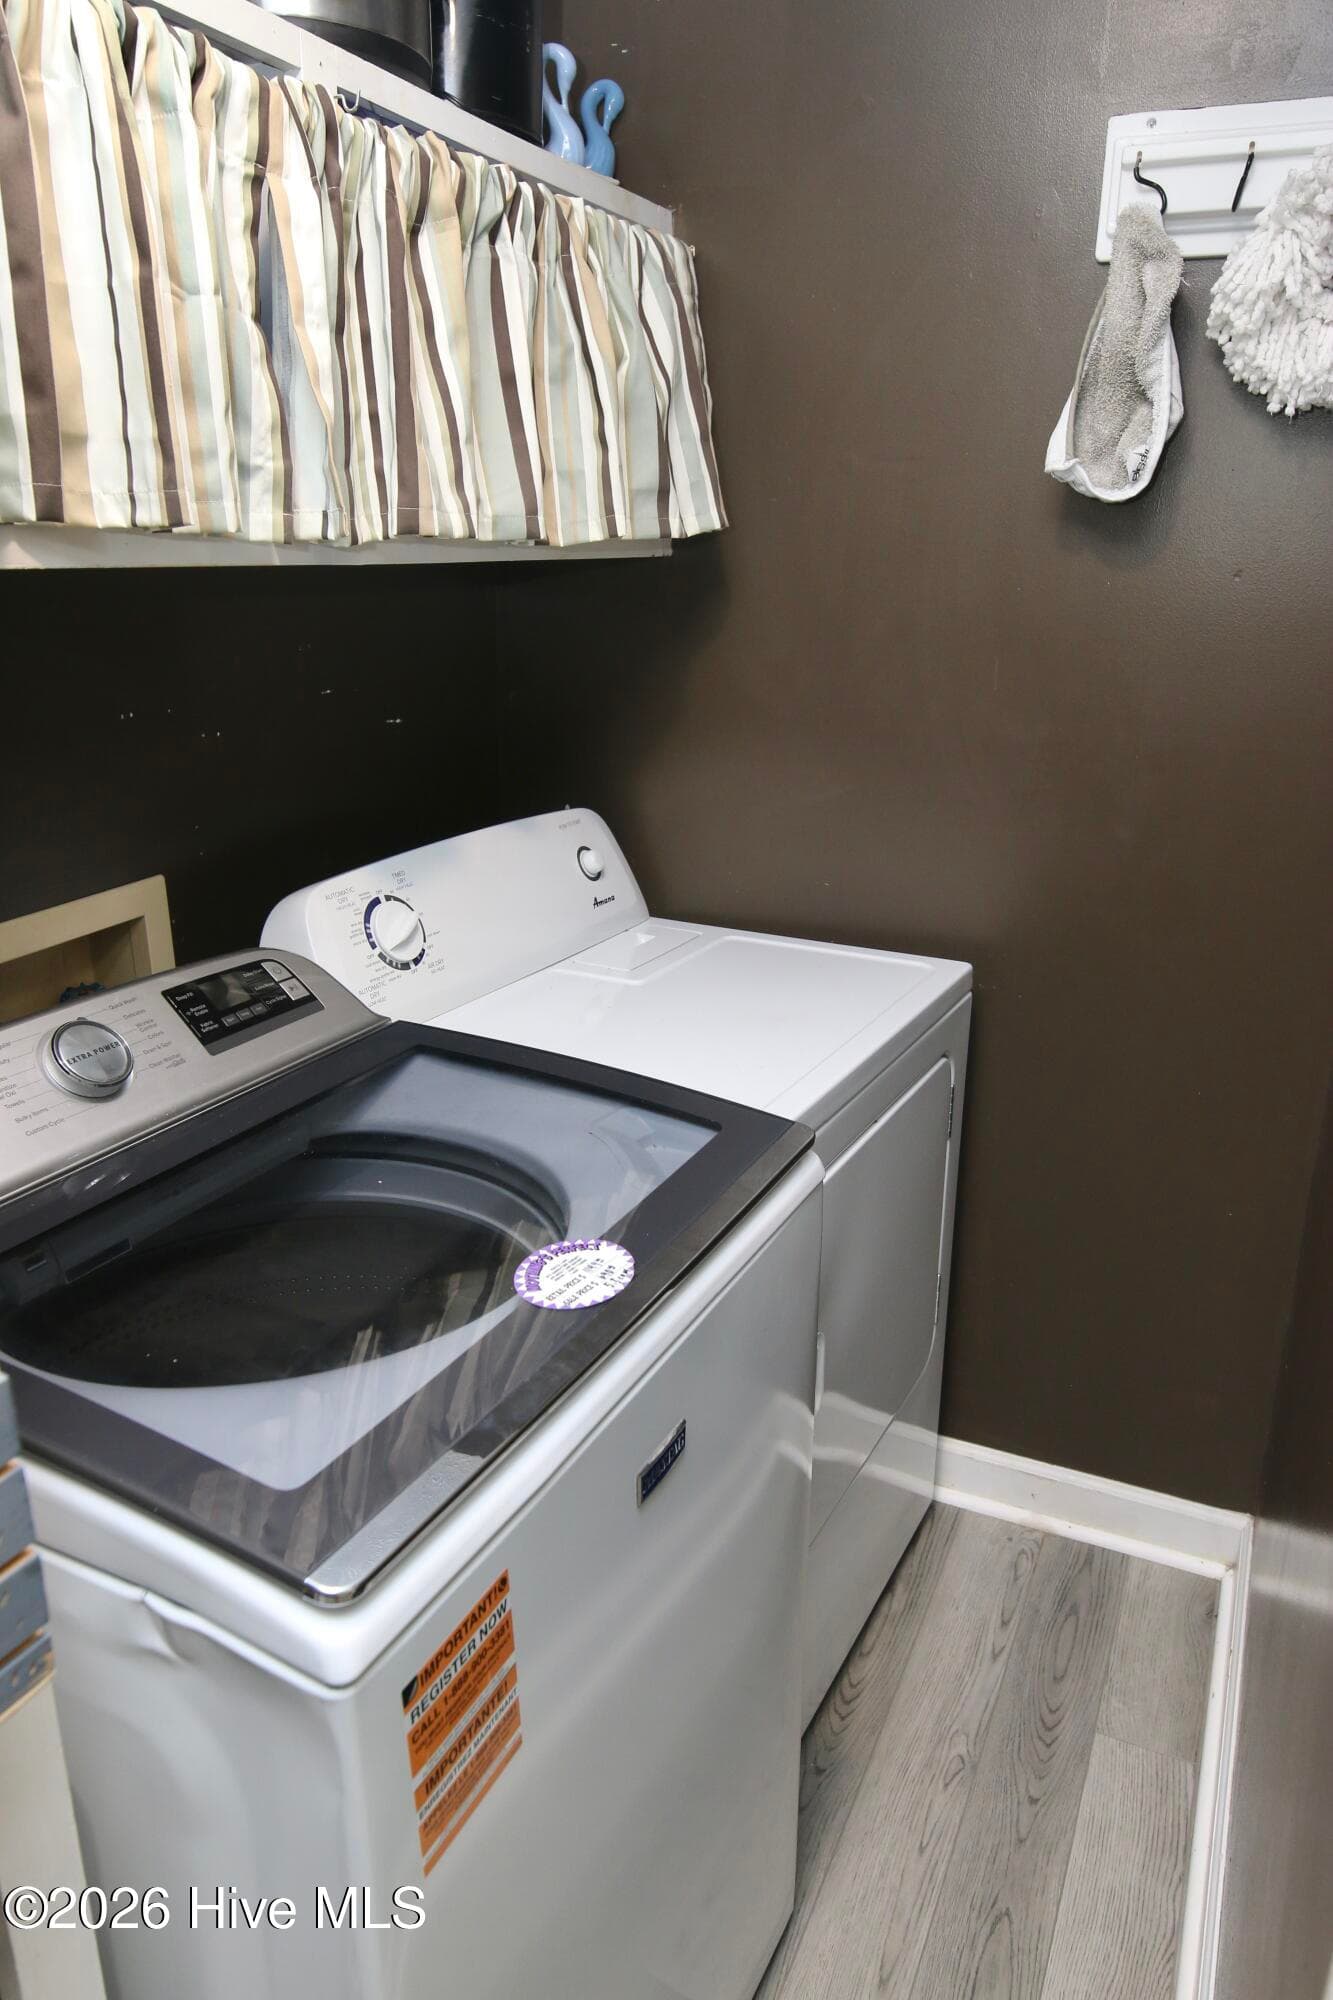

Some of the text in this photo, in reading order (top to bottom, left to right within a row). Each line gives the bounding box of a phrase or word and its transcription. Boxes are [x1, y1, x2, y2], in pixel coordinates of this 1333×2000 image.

[592, 895, 616, 910] Amana
[66, 1041, 121, 1065] EXTRA POWER
[410, 1638, 477, 1724] REGISTER
[480, 1598, 508, 1642] NOW
[412, 1708, 440, 1744] CALL
[474, 1687, 518, 1750] MAINTENANT
